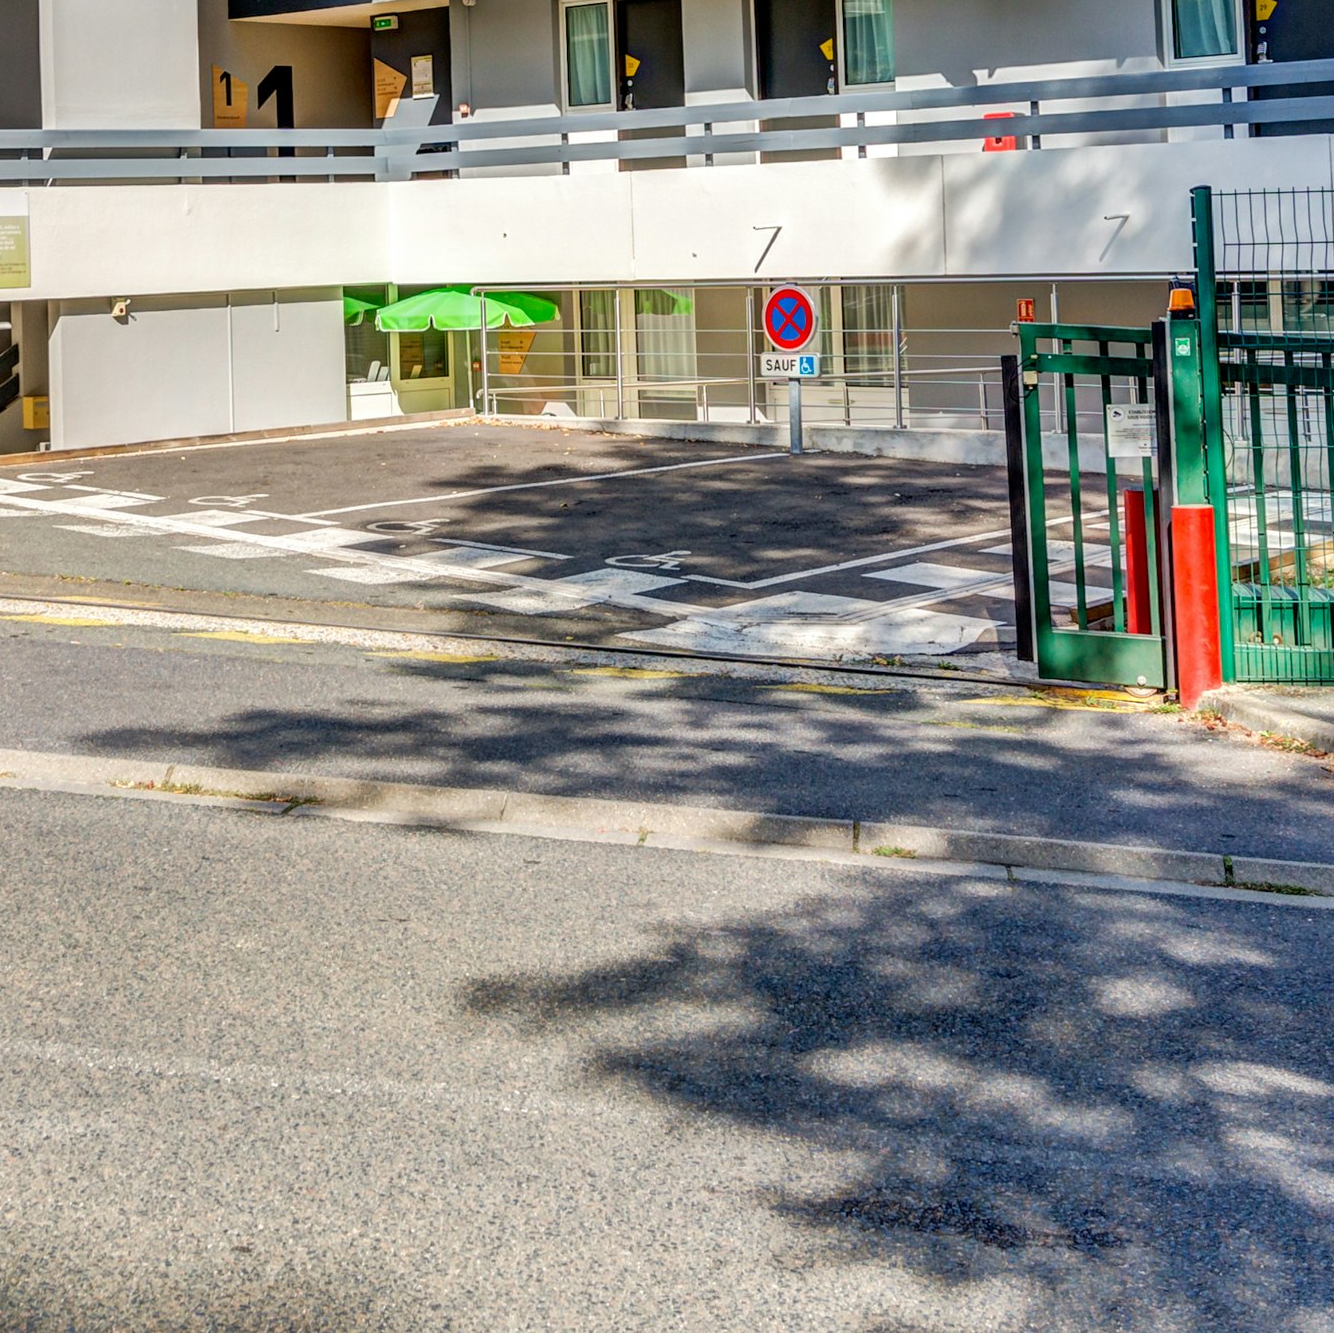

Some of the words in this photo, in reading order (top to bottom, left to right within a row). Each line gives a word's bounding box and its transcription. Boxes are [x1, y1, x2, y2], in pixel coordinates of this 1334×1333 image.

[220, 71, 232, 106] 1
[257, 65, 295, 157] 1
[766, 359, 797, 372] SAUF
